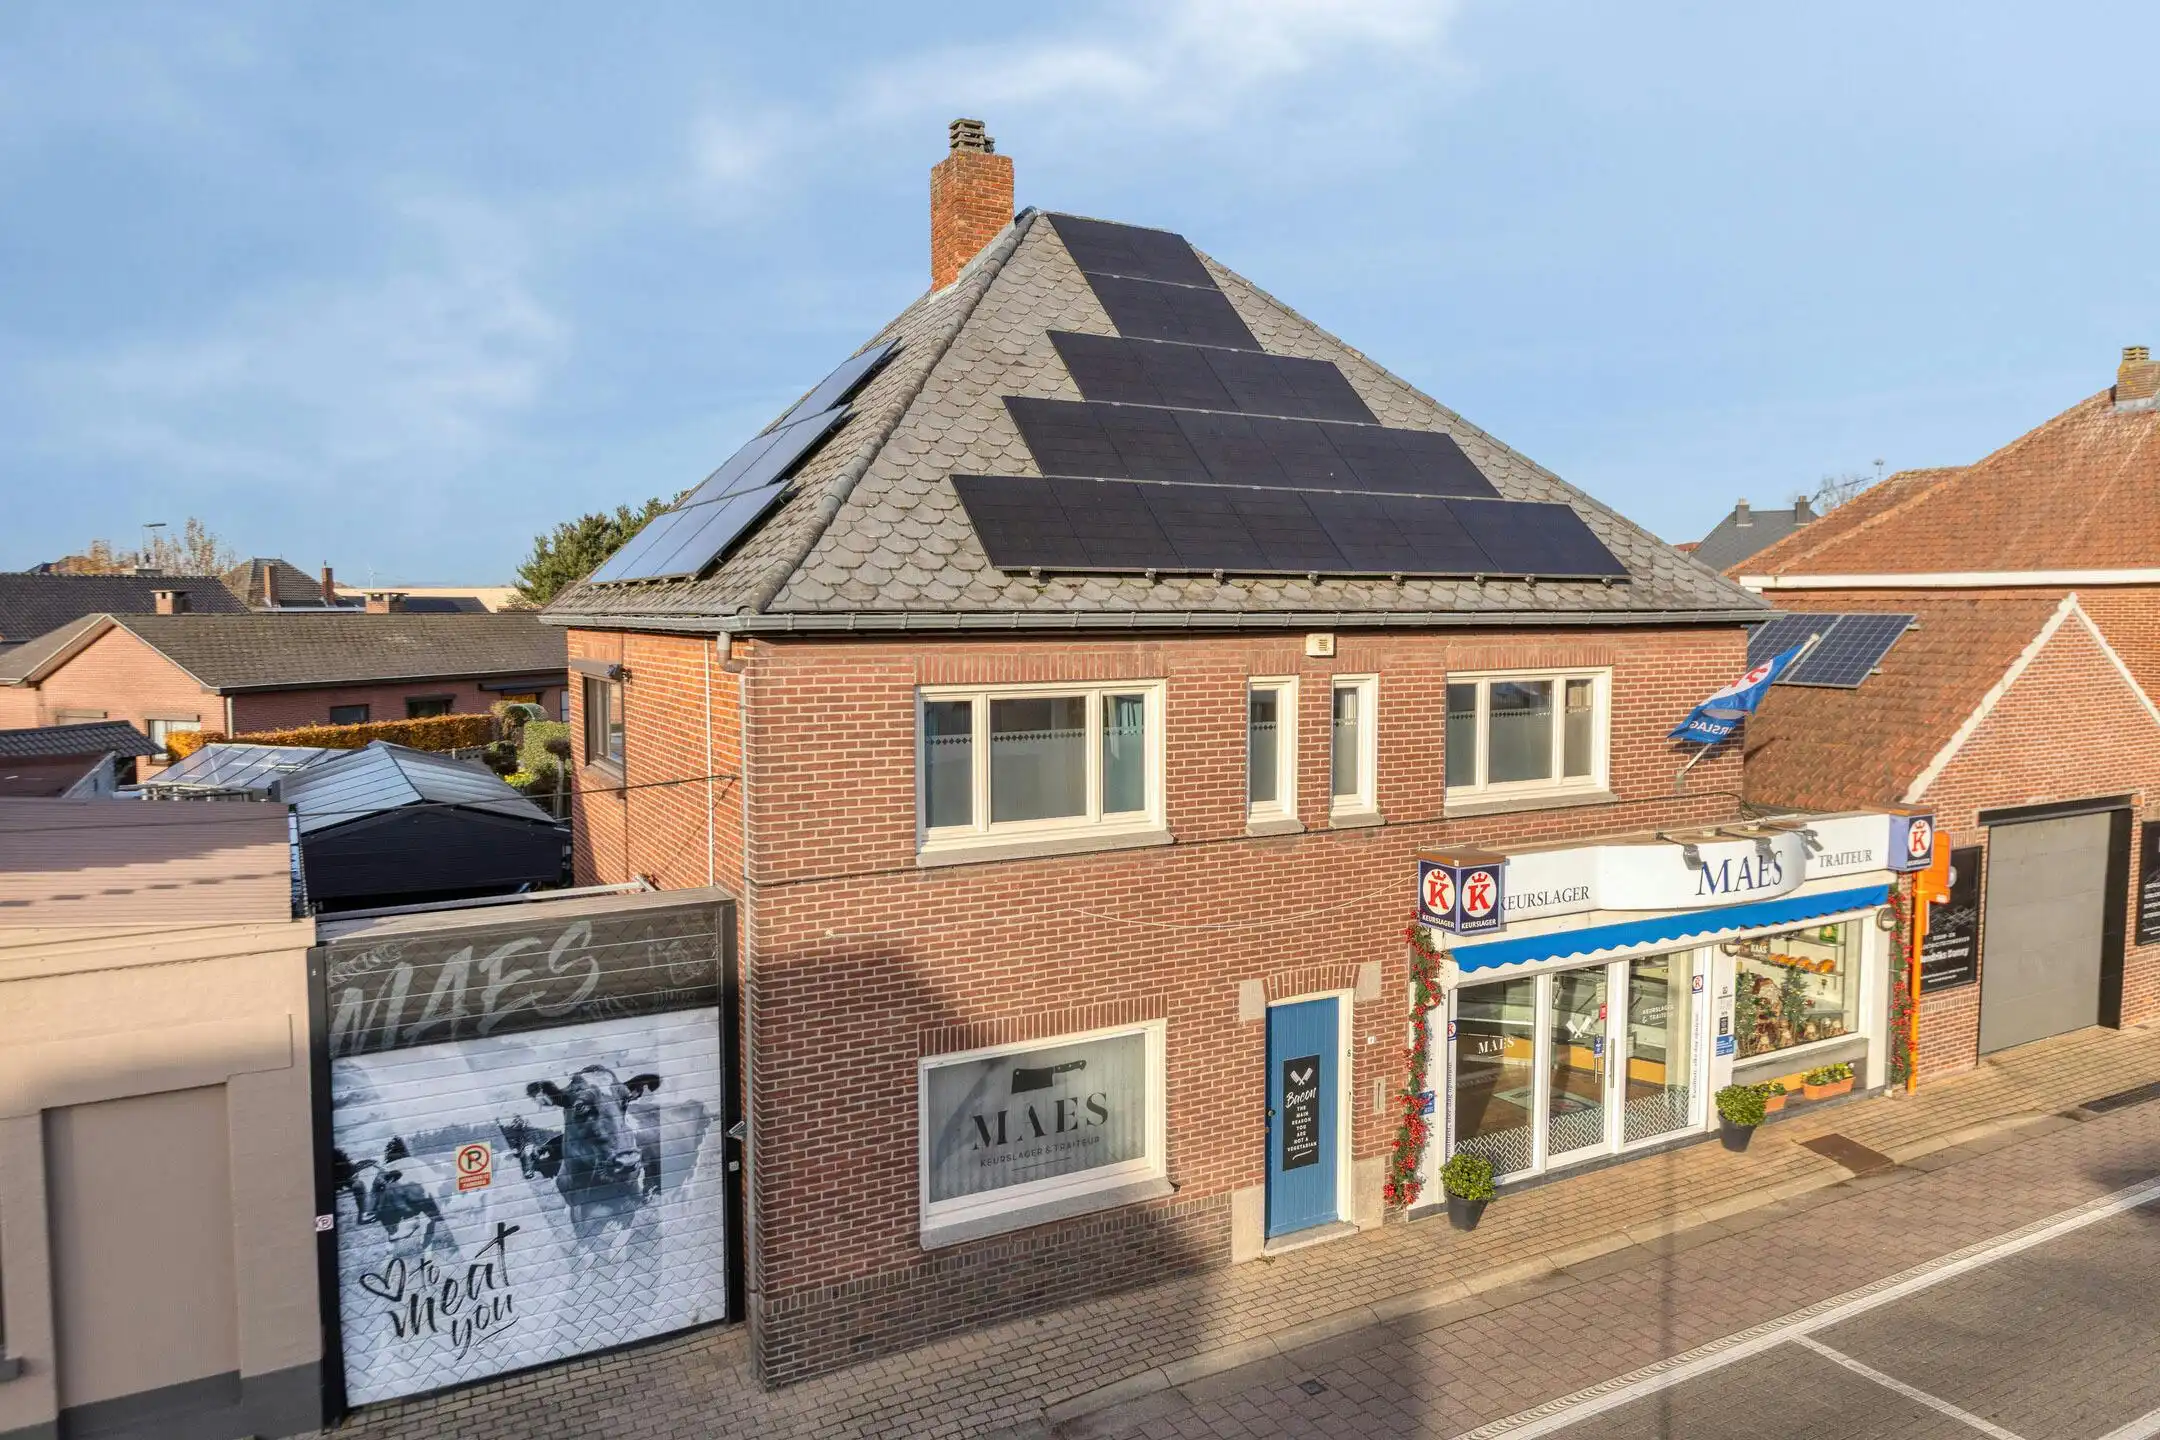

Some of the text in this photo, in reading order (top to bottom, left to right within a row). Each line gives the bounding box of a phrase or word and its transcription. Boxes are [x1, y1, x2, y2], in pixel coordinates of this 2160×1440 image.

[1819, 849, 1873, 868] TRAITEUR
[1695, 850, 1783, 896] MAES
[1428, 880, 1449, 911] K
[1467, 883, 1491, 912] K
[1422, 914, 1455, 929] KEURSLAGER
[1461, 918, 1497, 930] KEURSLAGER
[1478, 1036, 1515, 1055] MAES
[1285, 1087, 1317, 1109] Bacon
[972, 1092, 1109, 1151] MAES
[1291, 1117, 1312, 1126] REASON
[1287, 1141, 1318, 1152] VEGETARIAN
[1293, 1137, 1304, 1145] NOT
[980, 1136, 1100, 1167] KEURSLAGER & TRAITEUR
[452, 1294, 513, 1361] you
